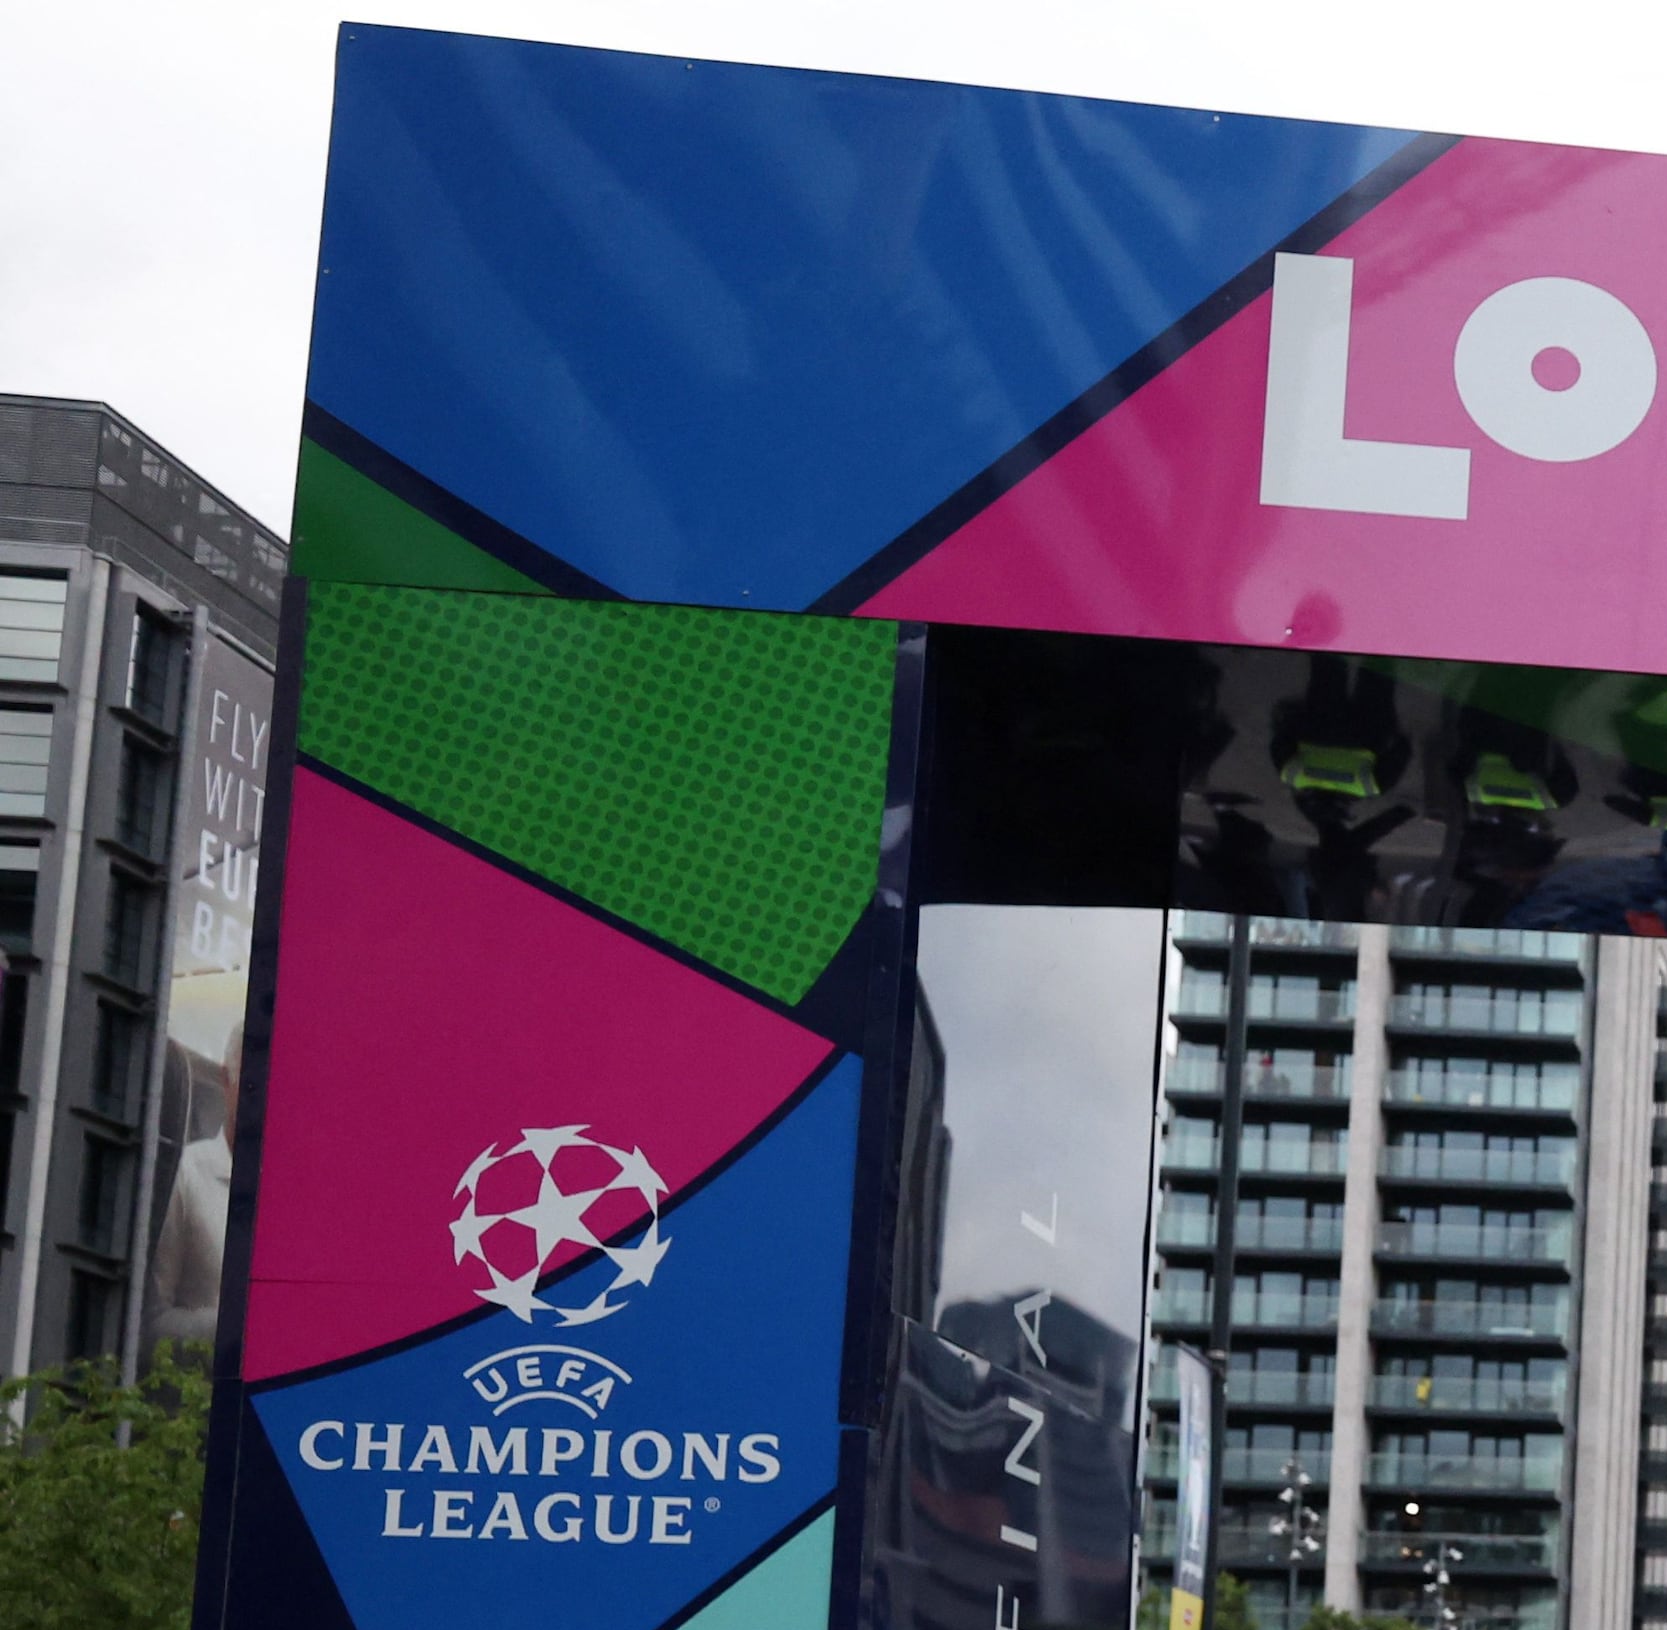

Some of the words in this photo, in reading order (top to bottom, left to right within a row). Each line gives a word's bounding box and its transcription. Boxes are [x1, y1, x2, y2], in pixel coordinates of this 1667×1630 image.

[209, 688, 267, 770] FLY
[473, 1356, 615, 1410] UEFA
[299, 1420, 781, 1483] CHAMPIONS
